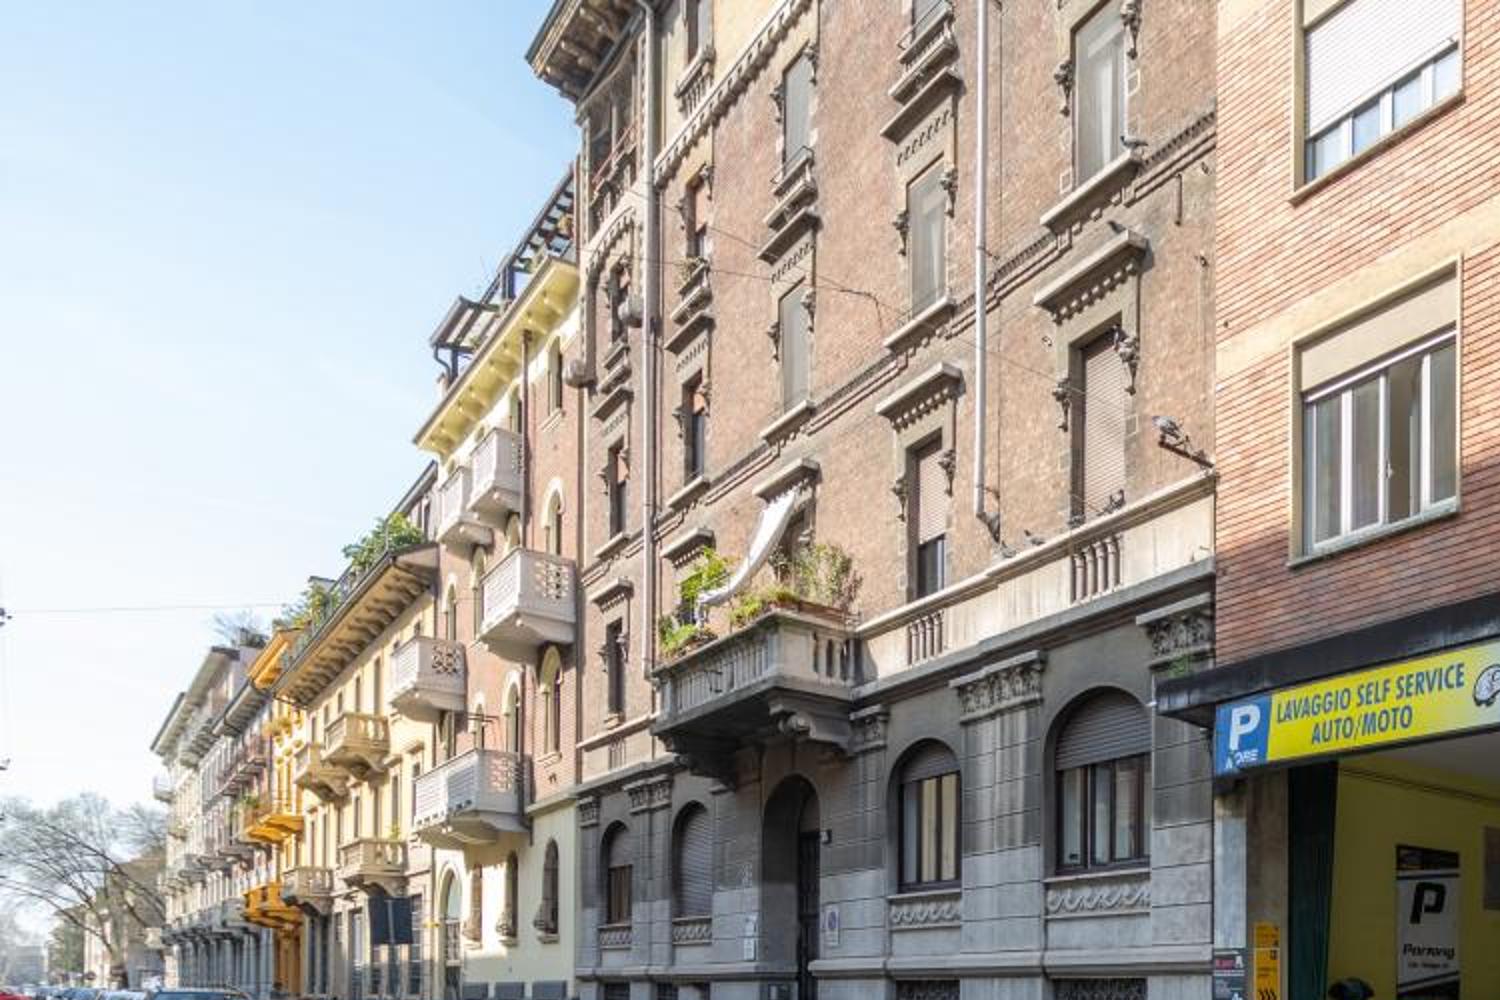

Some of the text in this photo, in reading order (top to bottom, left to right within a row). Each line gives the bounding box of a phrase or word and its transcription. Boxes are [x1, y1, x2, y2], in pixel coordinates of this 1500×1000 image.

[1276, 662, 1466, 724] LAVAGGIO SELF SERVICE
[1229, 703, 1261, 751] P
[1311, 705, 1414, 744] AUTO/MOTO
